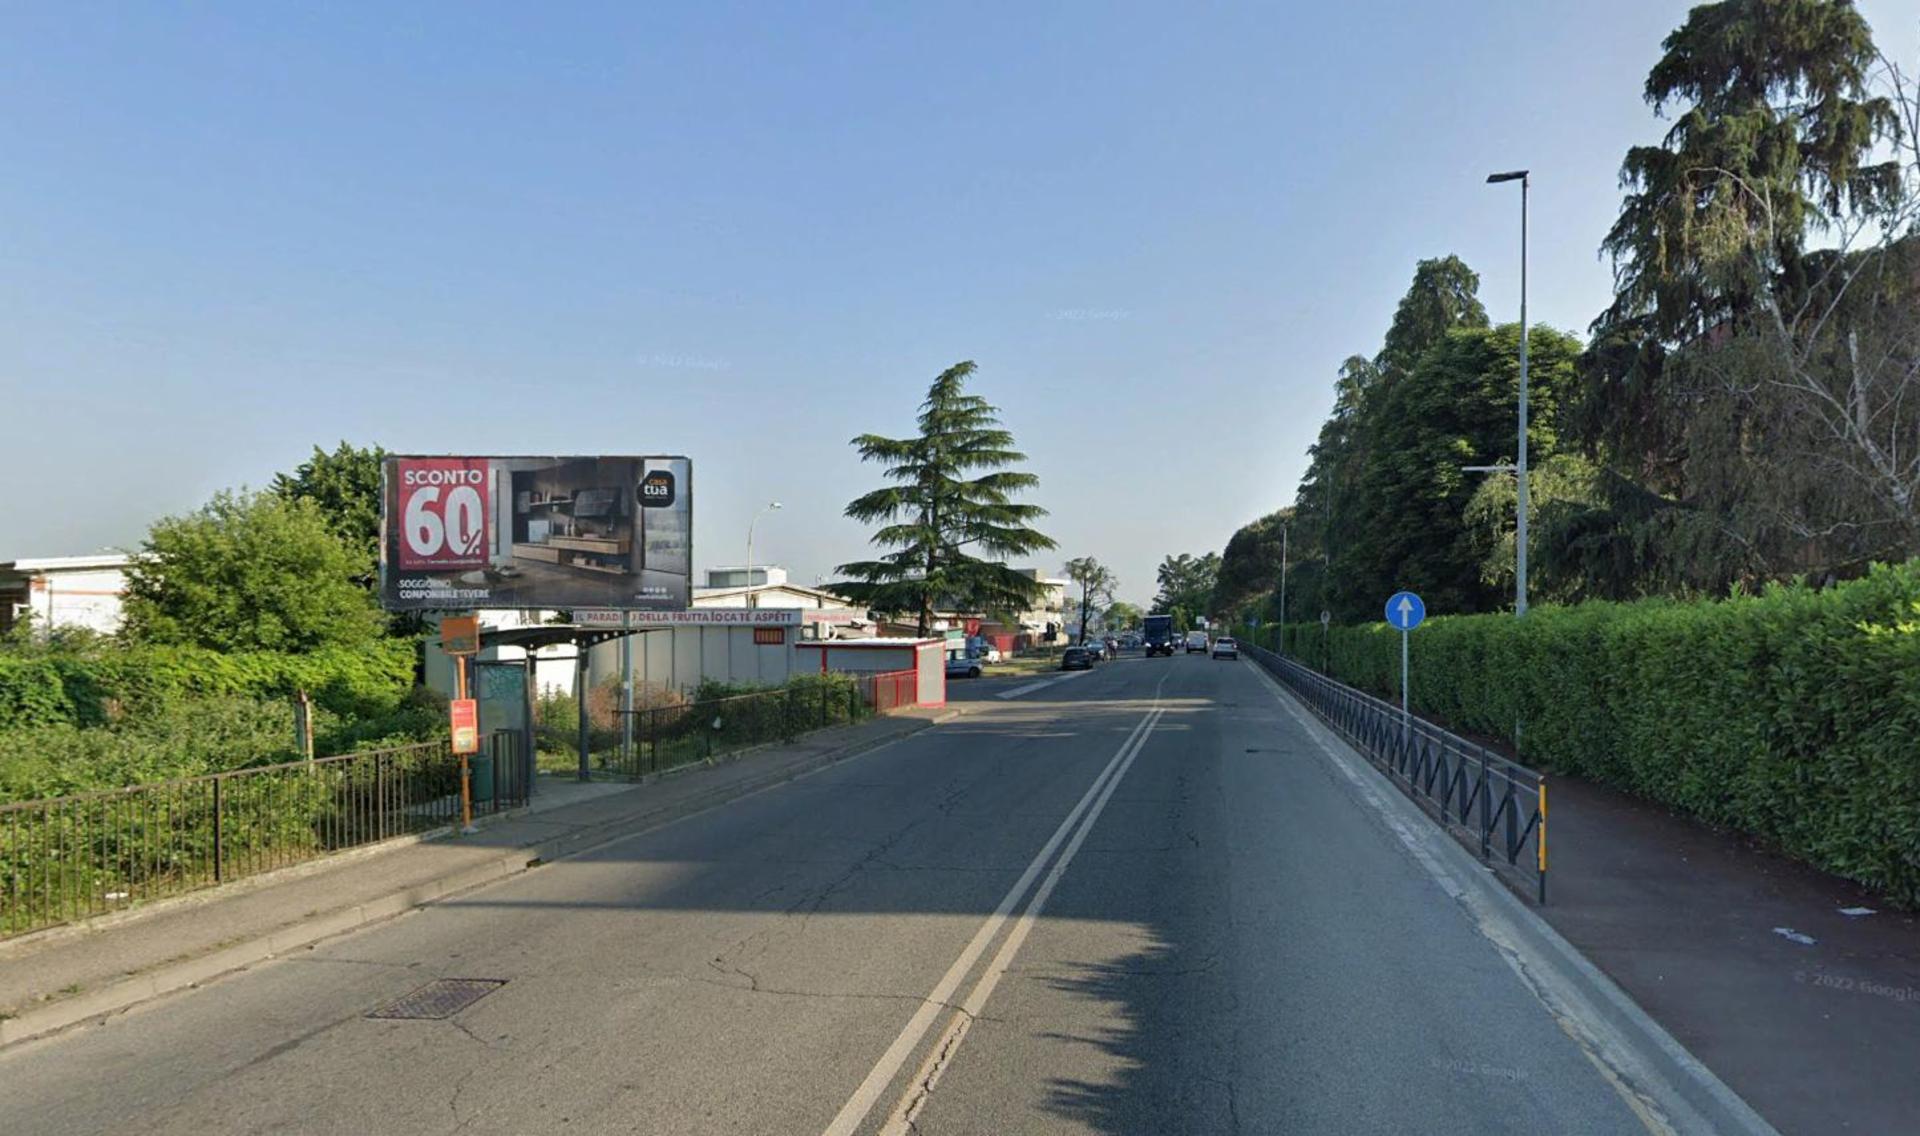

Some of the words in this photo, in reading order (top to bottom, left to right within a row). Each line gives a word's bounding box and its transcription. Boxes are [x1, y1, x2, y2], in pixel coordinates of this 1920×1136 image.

[404, 470, 483, 484] SCONTO
[644, 484, 669, 495] tua
[639, 612, 669, 622] DELLA
[671, 612, 710, 622] FRUTTA
